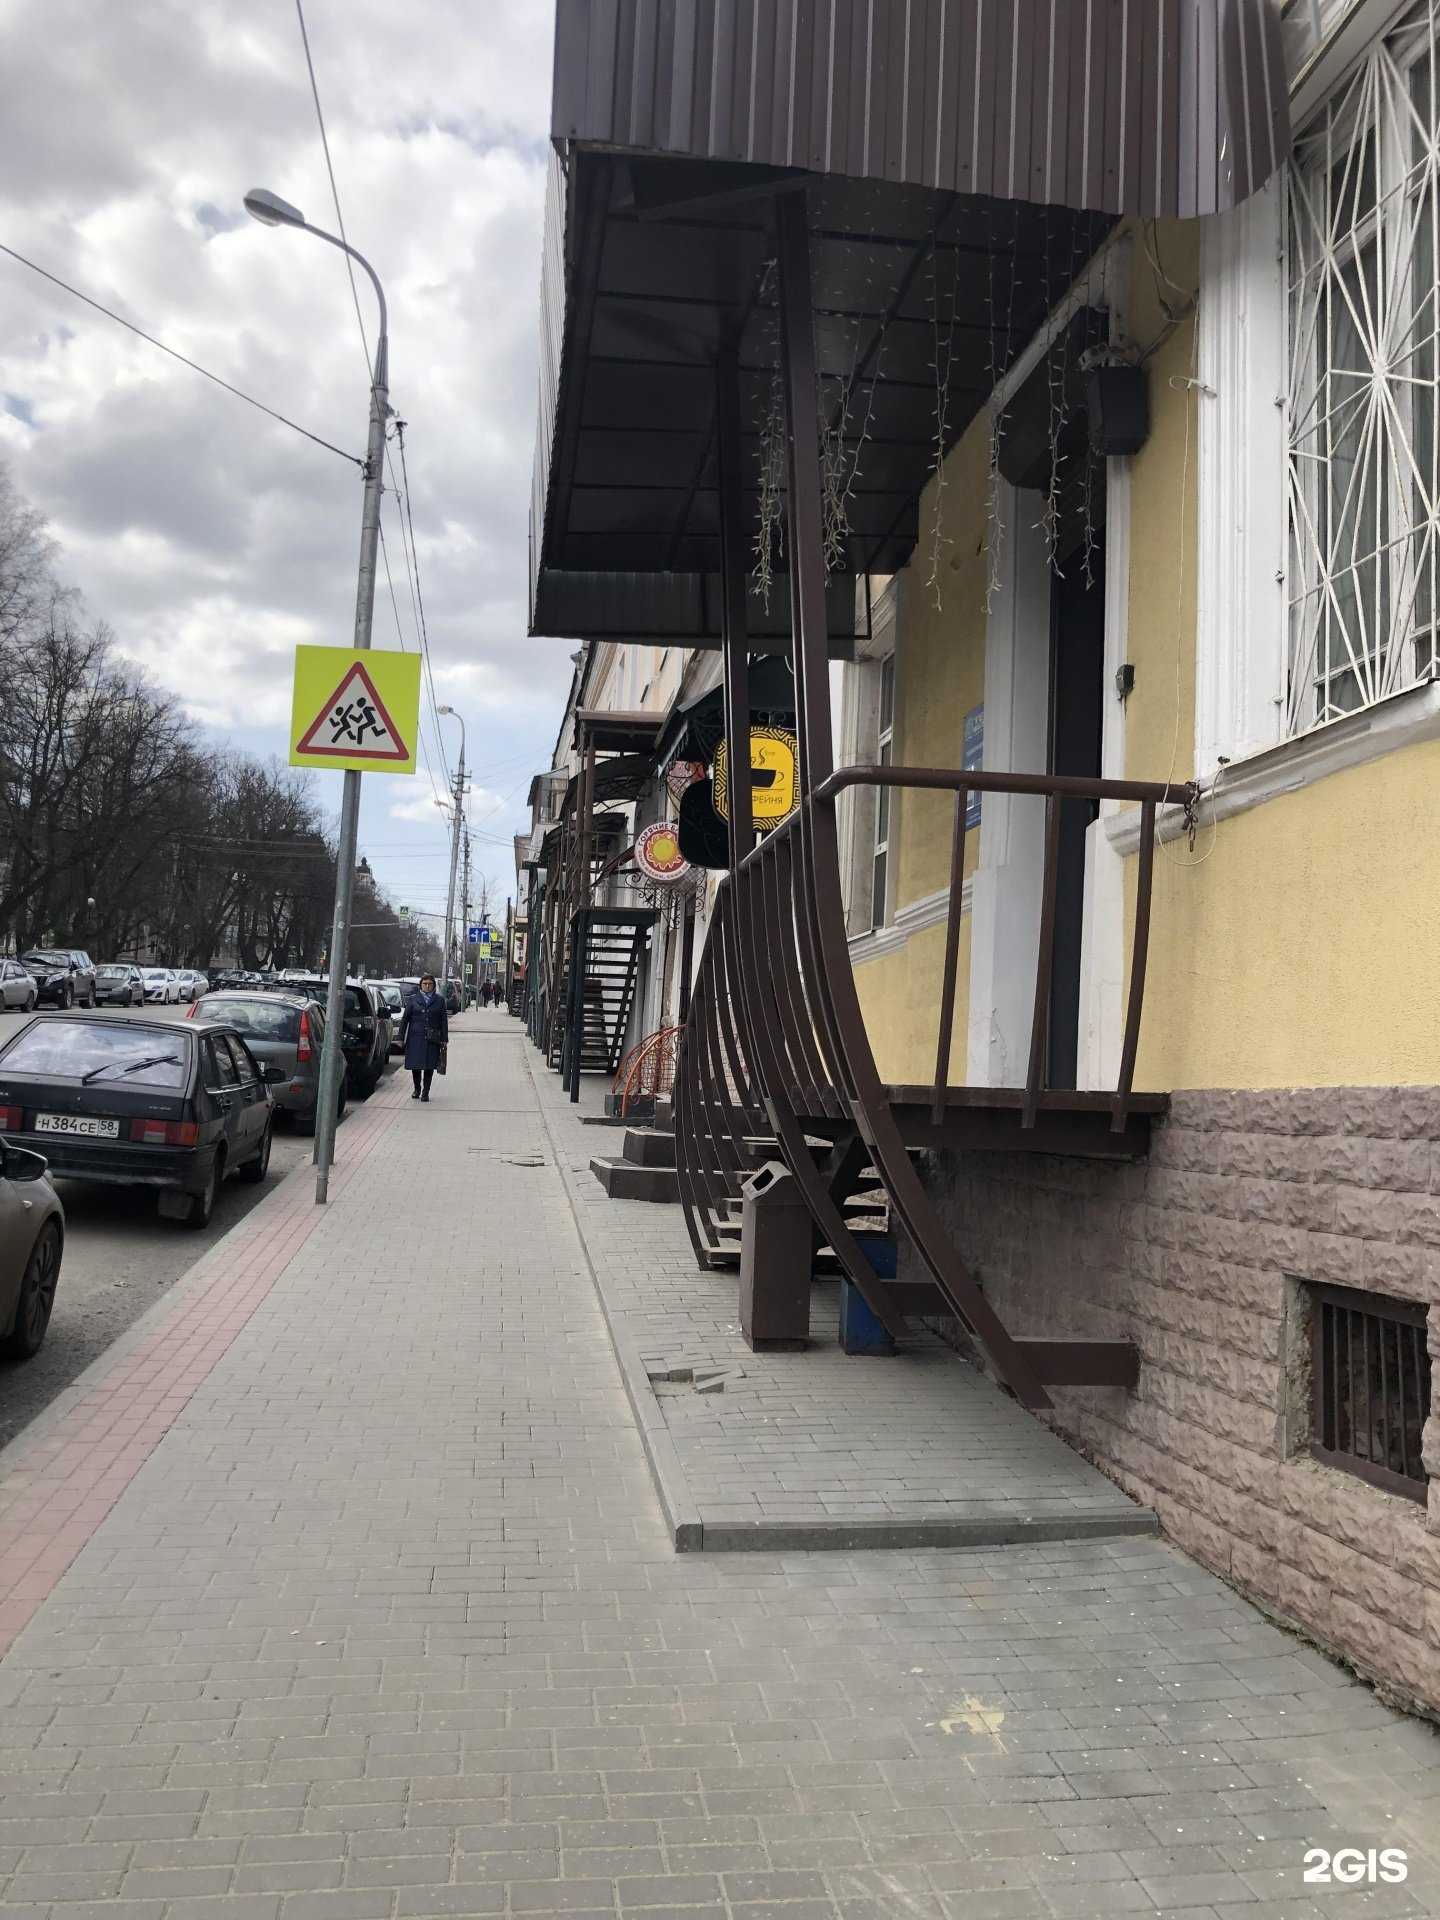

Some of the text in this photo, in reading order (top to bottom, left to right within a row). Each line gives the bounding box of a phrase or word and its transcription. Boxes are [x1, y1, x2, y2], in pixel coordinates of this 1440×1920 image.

[752, 795, 783, 805] ФЕЙНЯ
[638, 823, 669, 847] ГОРЯЧИЕ
[41, 1116, 114, 1133] Н384СЕ 58
